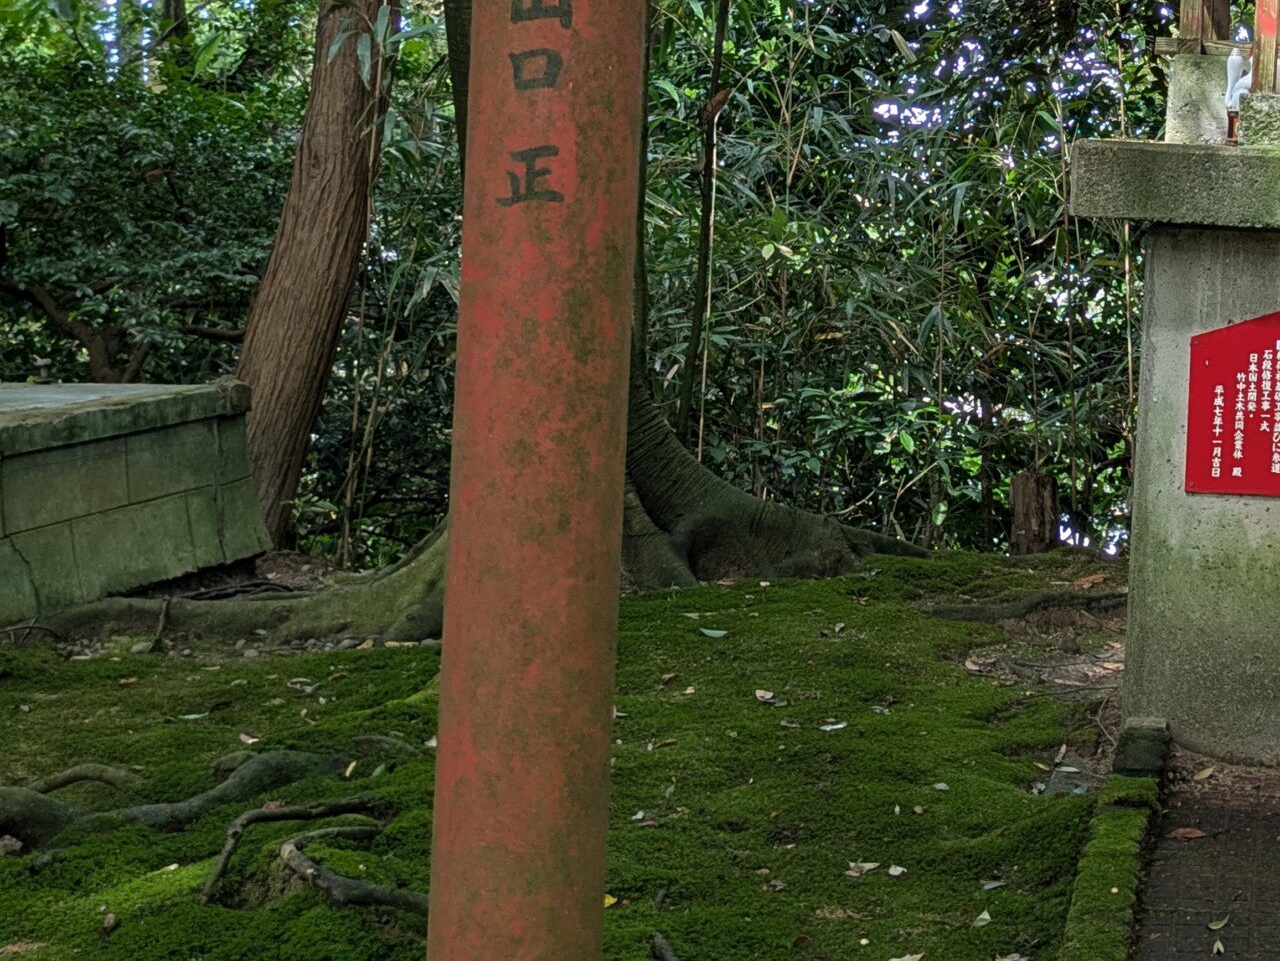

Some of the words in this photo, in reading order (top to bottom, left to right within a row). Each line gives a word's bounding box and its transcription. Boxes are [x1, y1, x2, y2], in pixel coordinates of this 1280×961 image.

[1211, 385, 1225, 478] 平成七年十一月吉日
